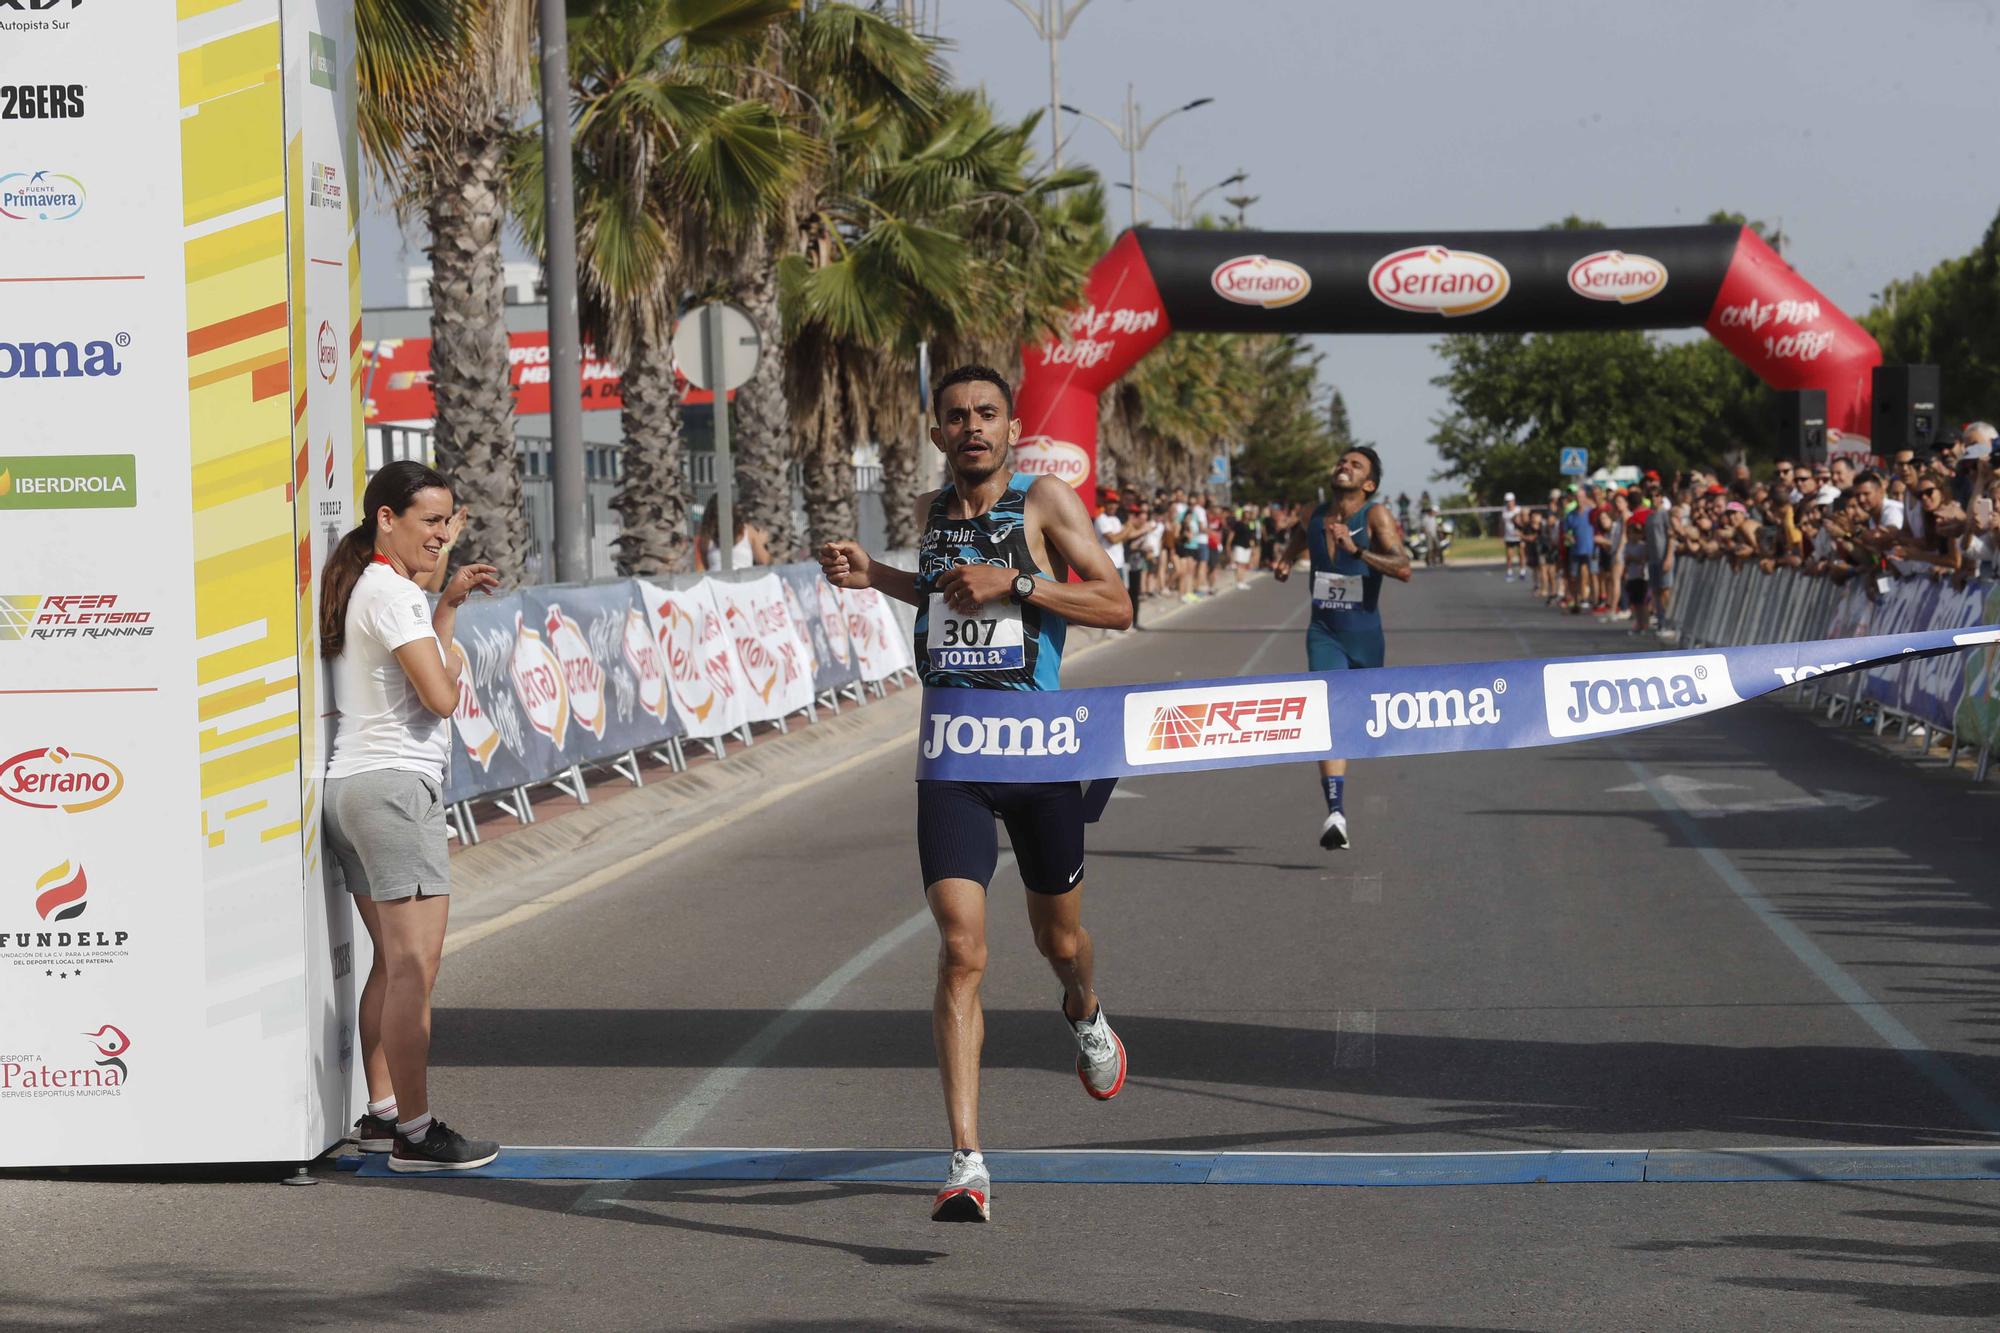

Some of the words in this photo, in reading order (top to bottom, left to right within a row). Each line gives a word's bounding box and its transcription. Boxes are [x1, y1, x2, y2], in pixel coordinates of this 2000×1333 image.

[0, 20, 49, 32] Autopista
[52, 20, 70, 30] Sur
[4, 191, 76, 207] Primavera
[1225, 270, 1300, 291] Serrano
[1387, 266, 1494, 294] Serrano
[1581, 267, 1656, 288] Serrano
[0, 338, 122, 379] oma
[15, 475, 126, 494] IBERDROLA
[1328, 587, 1346, 600] 57
[43, 595, 118, 612] RFEA
[37, 612, 151, 625] ATLETISMO
[31, 628, 77, 640] RUTA
[82, 627, 154, 639] RUNNING
[943, 619, 997, 646] 307
[938, 650, 1003, 669] Joma
[923, 713, 1081, 759] Joma
[1206, 696, 1307, 731] RFEA
[1365, 687, 1501, 738] Joma
[1567, 673, 1707, 723] Joma
[1203, 727, 1301, 746] ATLETISMO
[9, 765, 110, 793] Serrano
[0, 931, 128, 948] FUNDELP
[1, 1063, 120, 1088] Paterna
[34, 1090, 75, 1098] ESPORTIUS
[76, 1089, 121, 1097] MUNICIPALS
